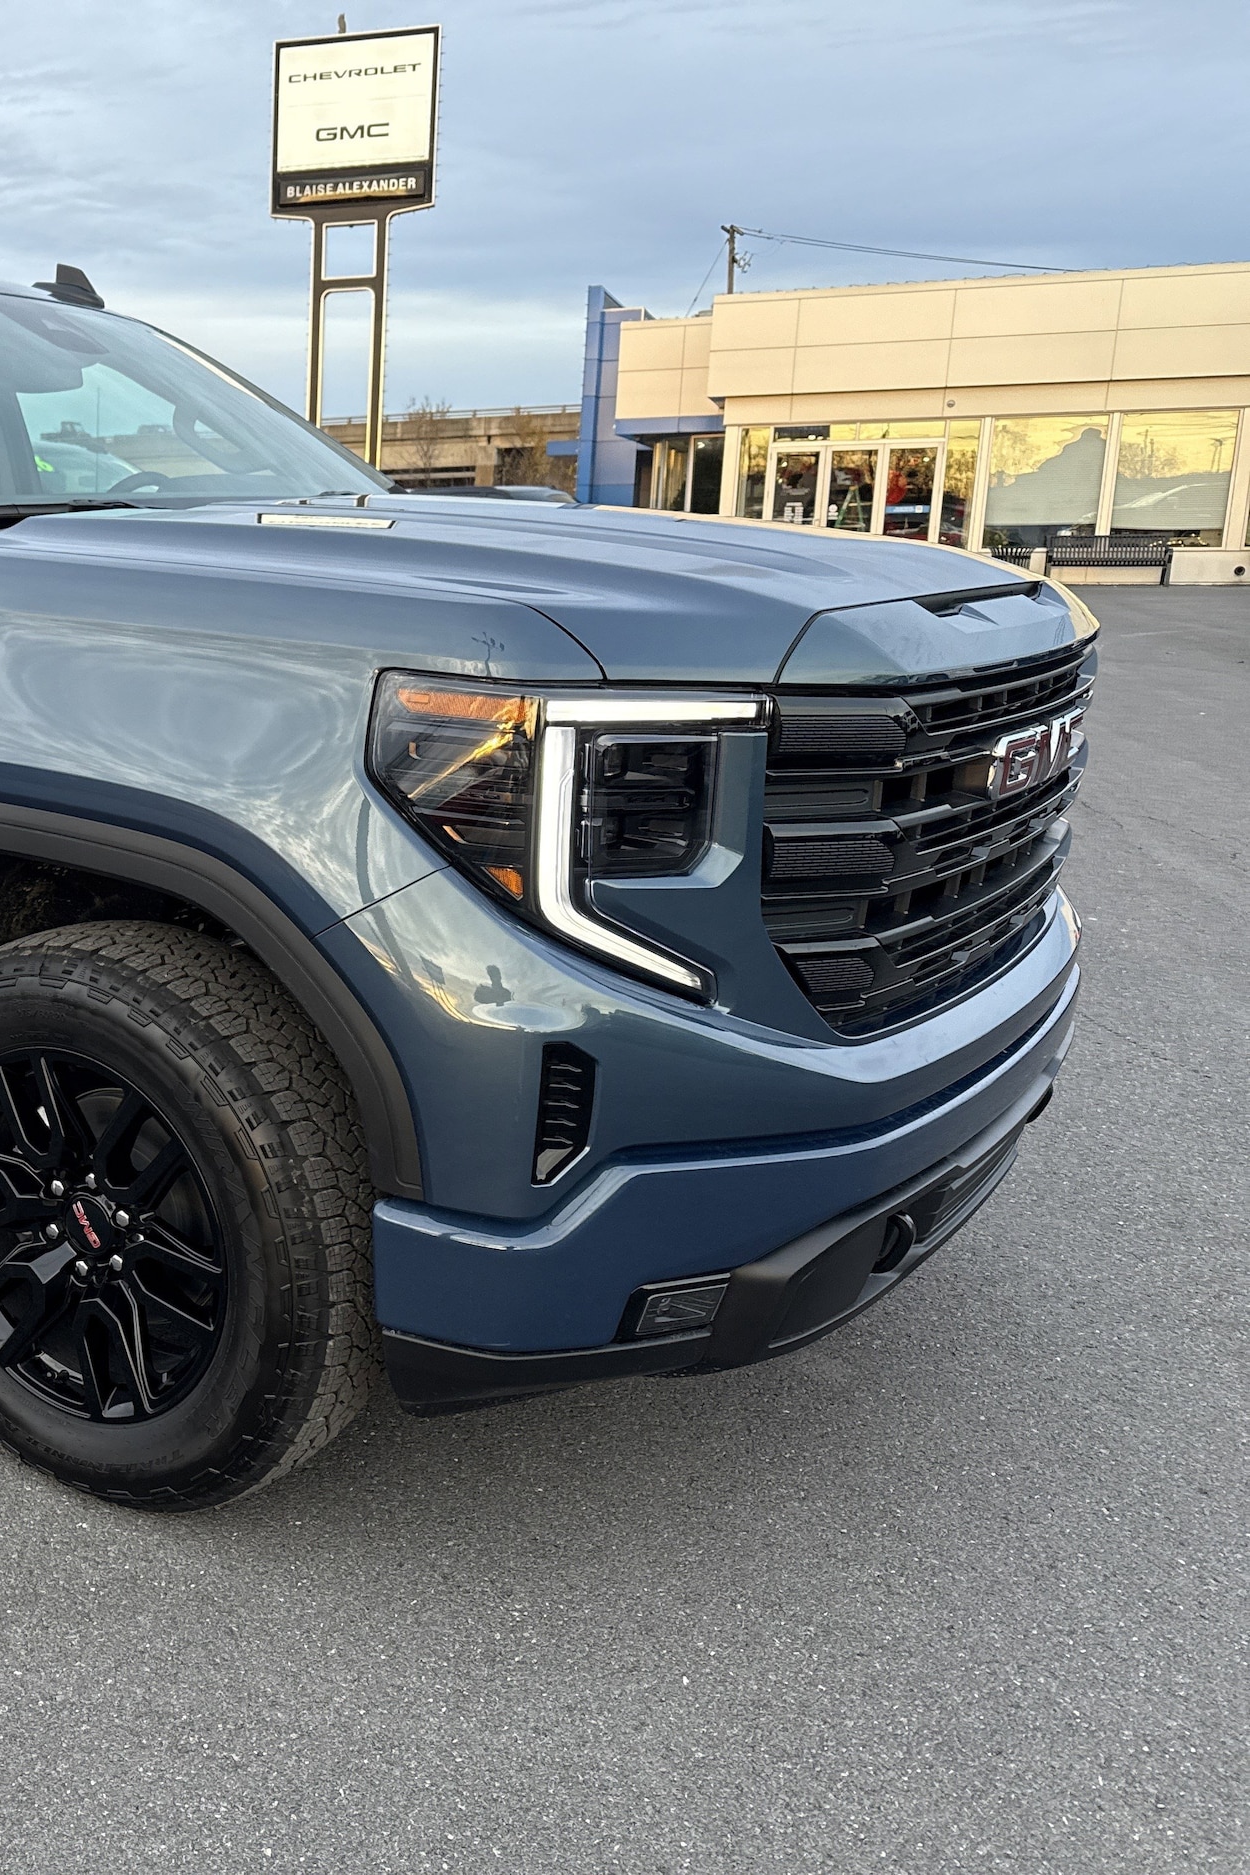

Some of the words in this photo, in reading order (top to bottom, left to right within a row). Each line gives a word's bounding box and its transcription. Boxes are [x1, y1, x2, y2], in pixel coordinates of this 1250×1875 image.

[288, 62, 422, 84] CHEVROLET
[315, 122, 390, 142] GMC
[286, 181, 337, 198] BLAISE
[335, 177, 417, 194] ALEXANDER
[72, 1200, 101, 1249] GMC
